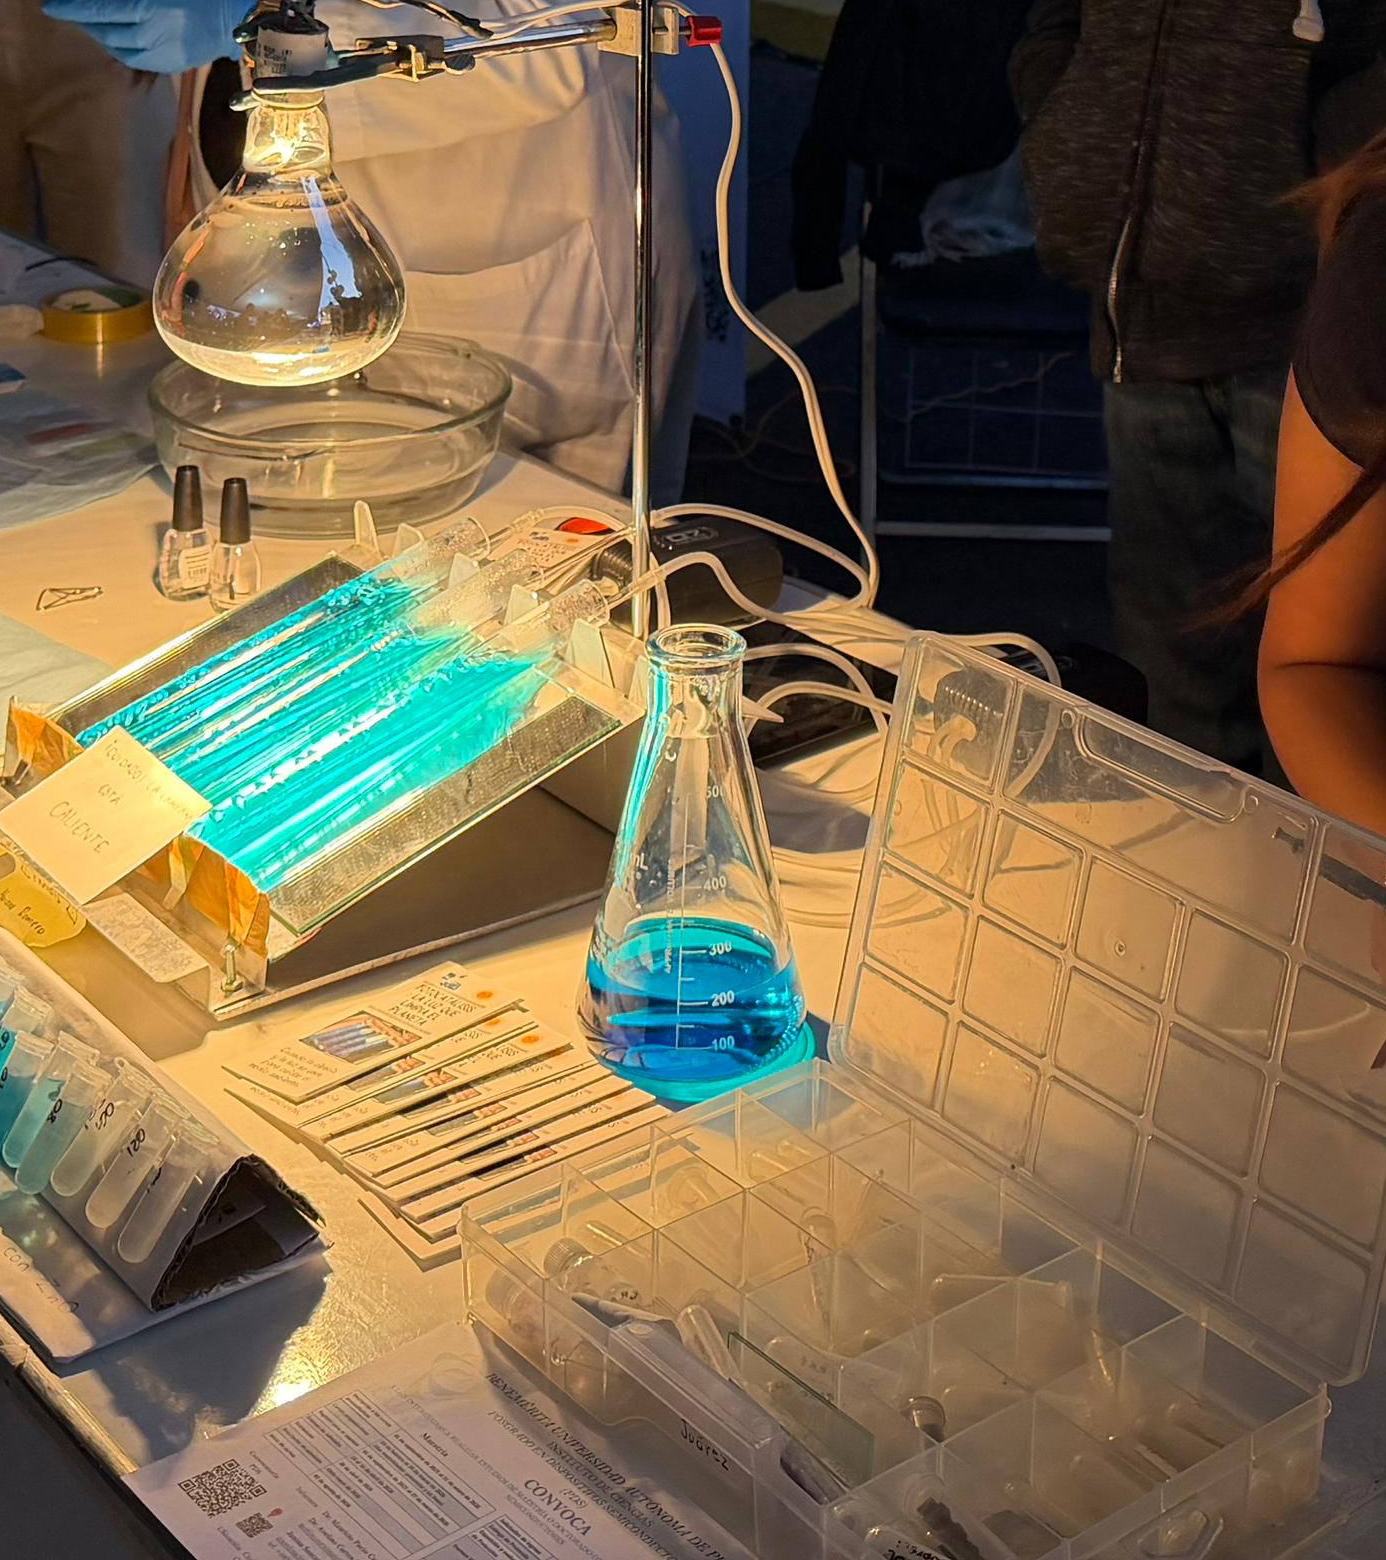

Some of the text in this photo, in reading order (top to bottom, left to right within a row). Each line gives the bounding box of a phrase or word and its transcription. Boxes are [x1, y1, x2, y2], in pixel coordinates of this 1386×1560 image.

[47, 799, 112, 857] CALIENTE
[703, 876, 727, 890] 400
[708, 941, 732, 955] 300
[711, 991, 735, 1006] 200
[711, 1036, 735, 1051] 100
[126, 1128, 145, 1157] 120
[2, 1247, 31, 1273] con
[486, 1372, 556, 1430] BENEMÉRITA
[551, 1426, 626, 1486] UNIVERSIDAD
[624, 1485, 689, 1538] AUTÓNOMA
[688, 1535, 710, 1559] DE
[488, 1410, 534, 1451] POSGRADO
[531, 1446, 547, 1464] EN
[546, 1457, 606, 1508] DISPOSITIVOS
[548, 1442, 653, 1528] INSTITUTO DE CIENCIAS
[524, 1479, 592, 1536] CONVOCA
